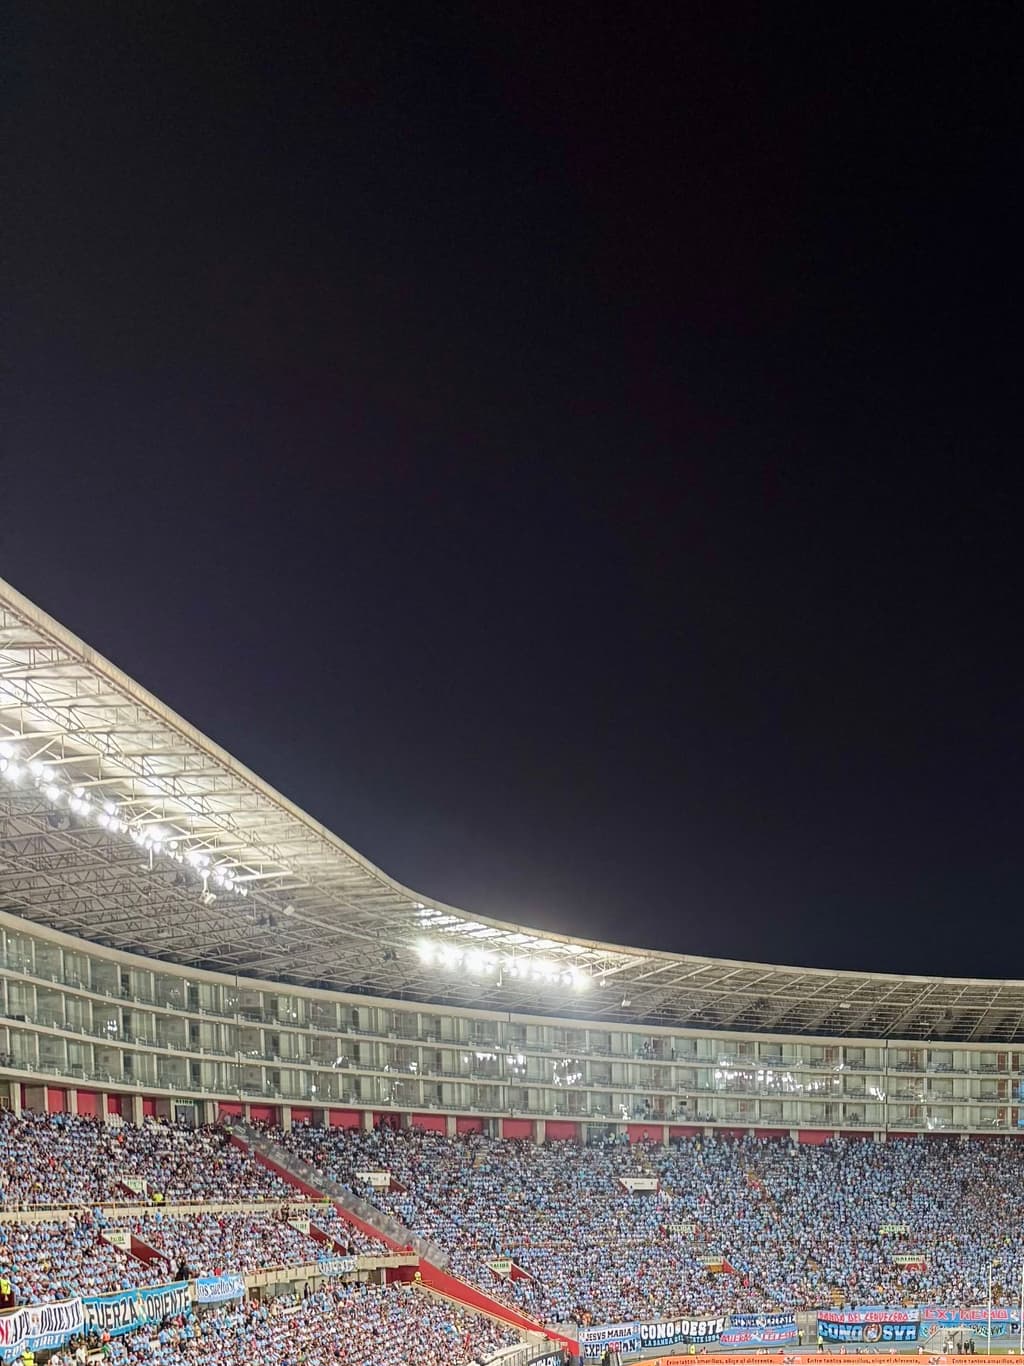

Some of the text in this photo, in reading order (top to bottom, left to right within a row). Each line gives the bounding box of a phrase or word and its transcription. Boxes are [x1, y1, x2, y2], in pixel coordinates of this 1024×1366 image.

[86, 1288, 190, 1329] FUERZA ORIENTE
[924, 1309, 1008, 1320] EXTREMO
[607, 1326, 632, 1338] MARIA
[641, 1321, 675, 1340] CONO
[681, 1318, 724, 1337] OESTE
[818, 1321, 863, 1340] CONO
